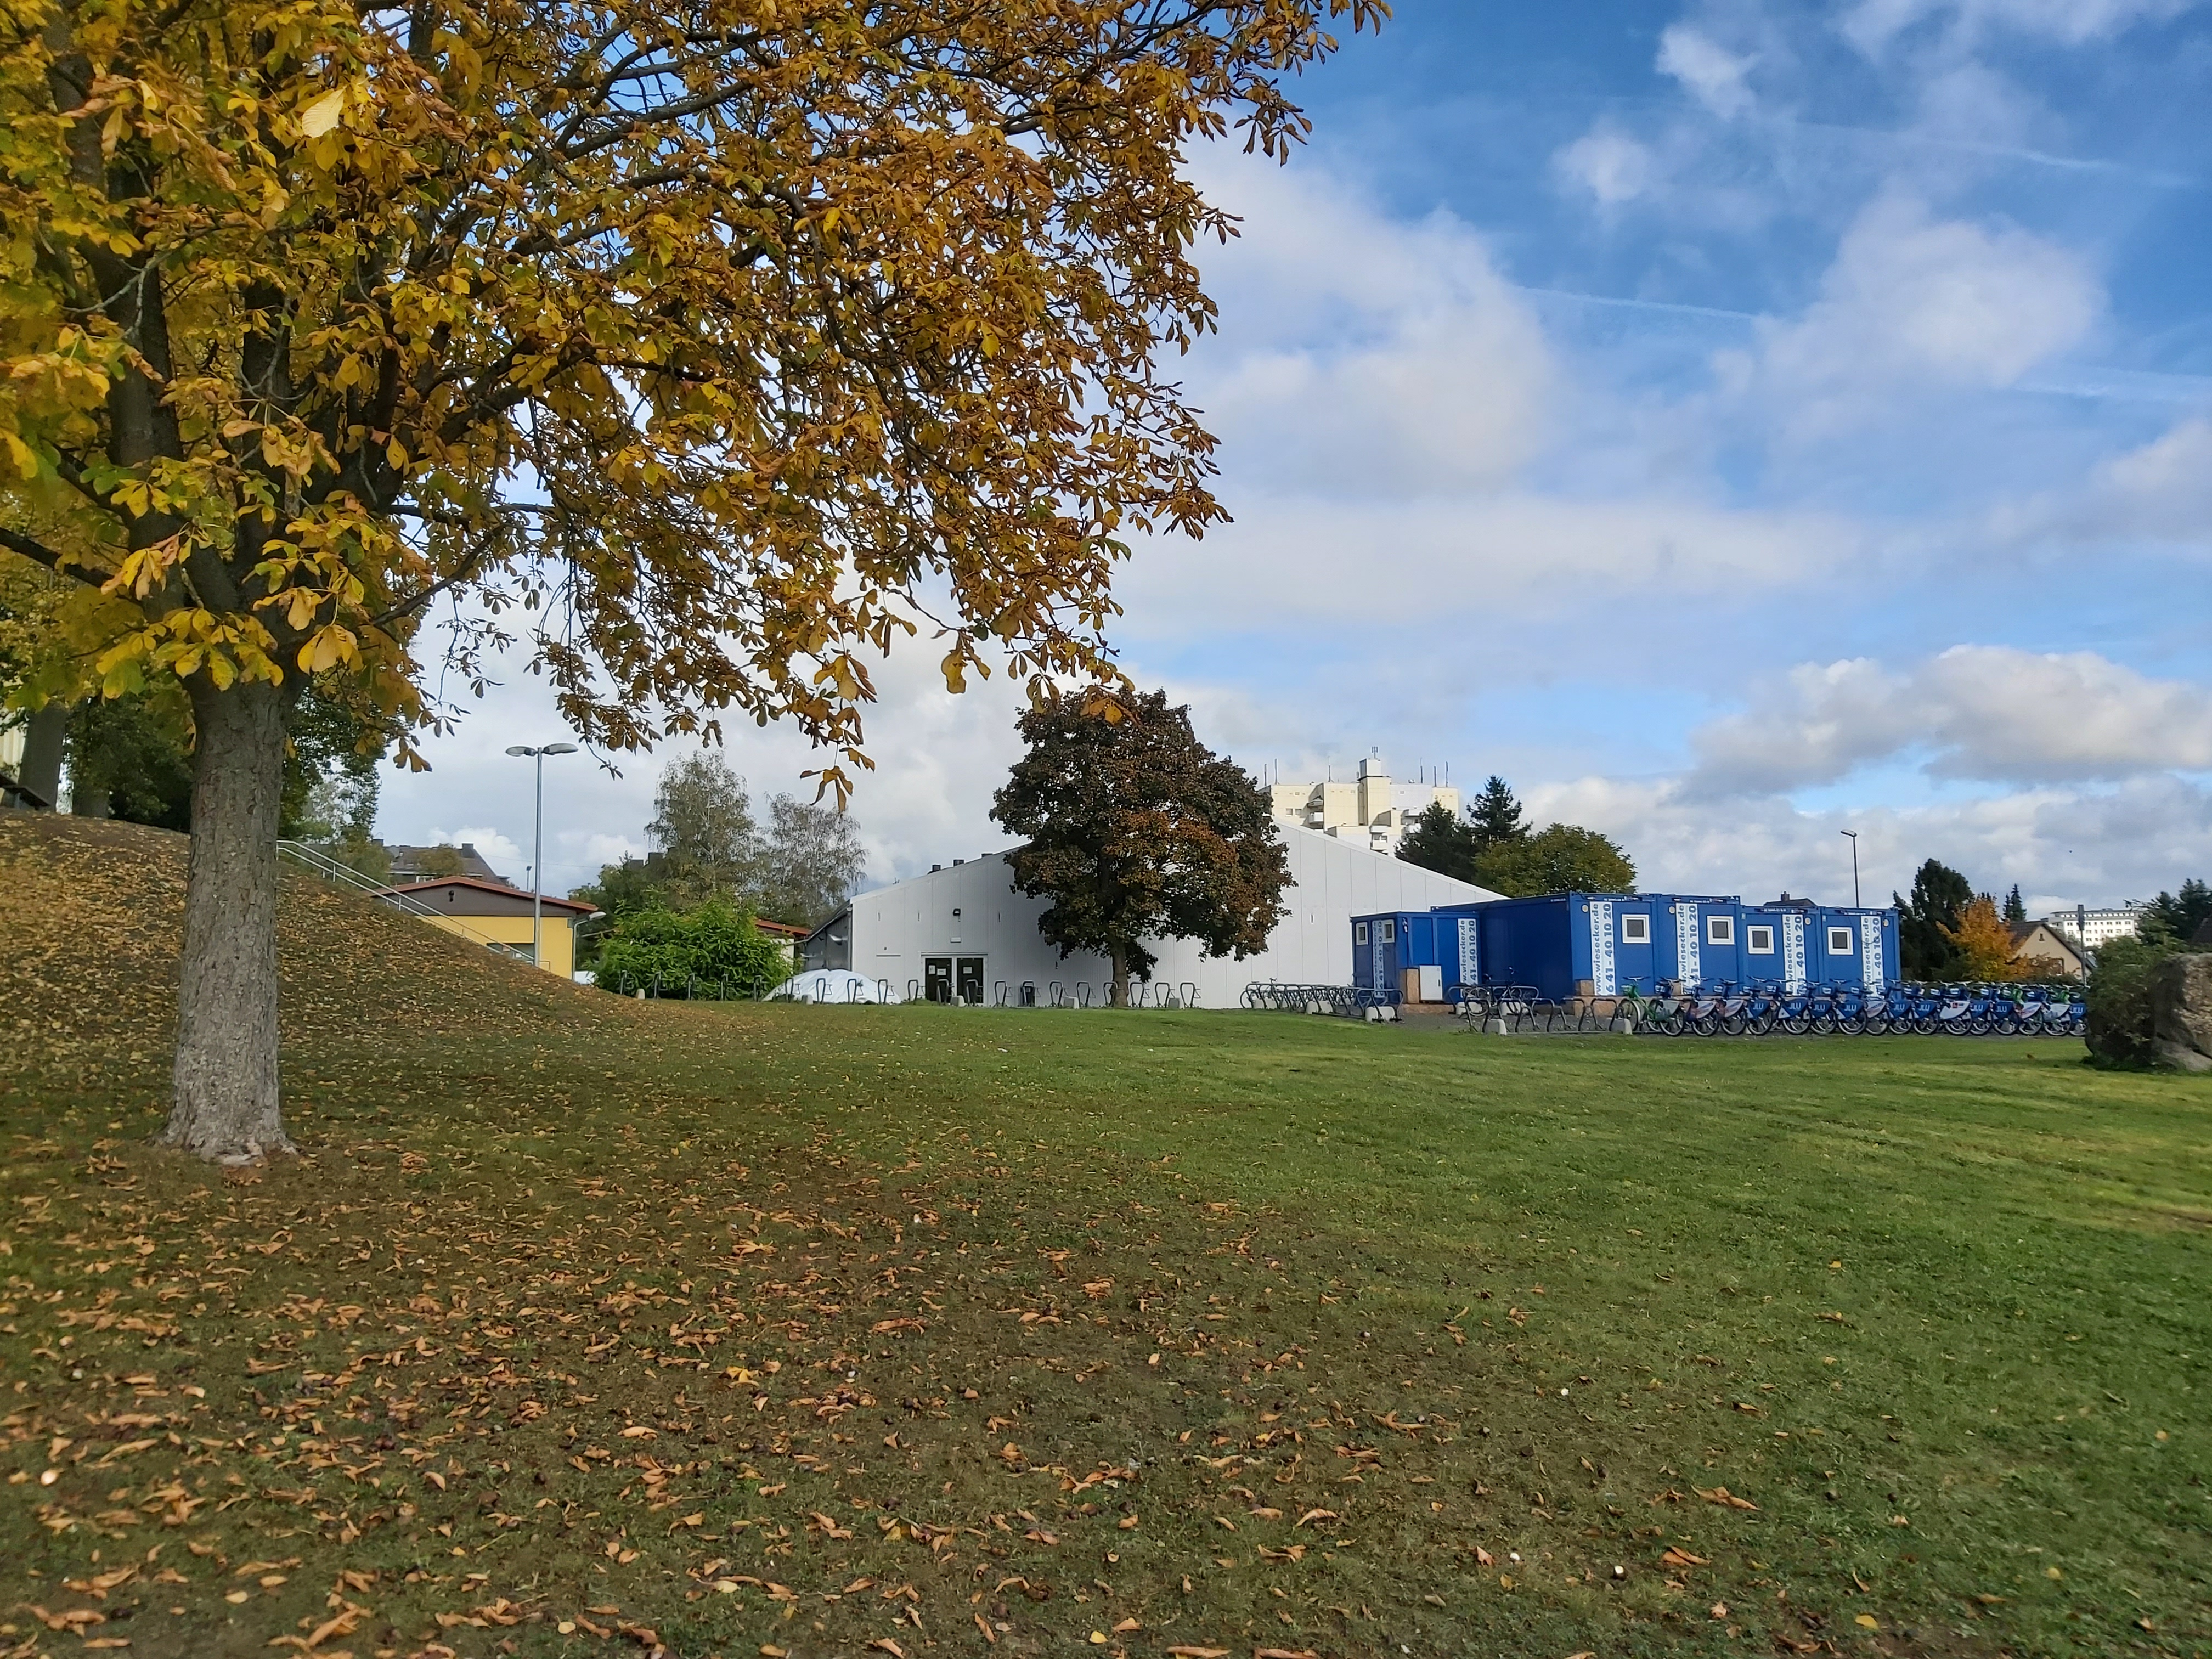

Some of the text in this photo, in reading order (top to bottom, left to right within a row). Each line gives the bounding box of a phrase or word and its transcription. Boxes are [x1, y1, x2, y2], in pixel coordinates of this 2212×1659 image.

[1603, 904, 1612, 919] 20
[1689, 905, 1696, 921] 20
[1469, 920, 1475, 933] 20
[1604, 923, 1612, 937] 10
[1689, 924, 1697, 938] 10
[1795, 916, 1802, 932] 20
[1872, 918, 1880, 933] 20
[1469, 935, 1475, 946] 10
[1795, 935, 1803, 948] 10
[1469, 949, 1476, 961] 40
[1604, 940, 1613, 957] 40
[1690, 941, 1698, 958] 40
[1796, 952, 1804, 968] 40
[1874, 953, 1882, 968] 40
[1470, 970, 1477, 981] 41
[1605, 968, 1613, 983] 41
